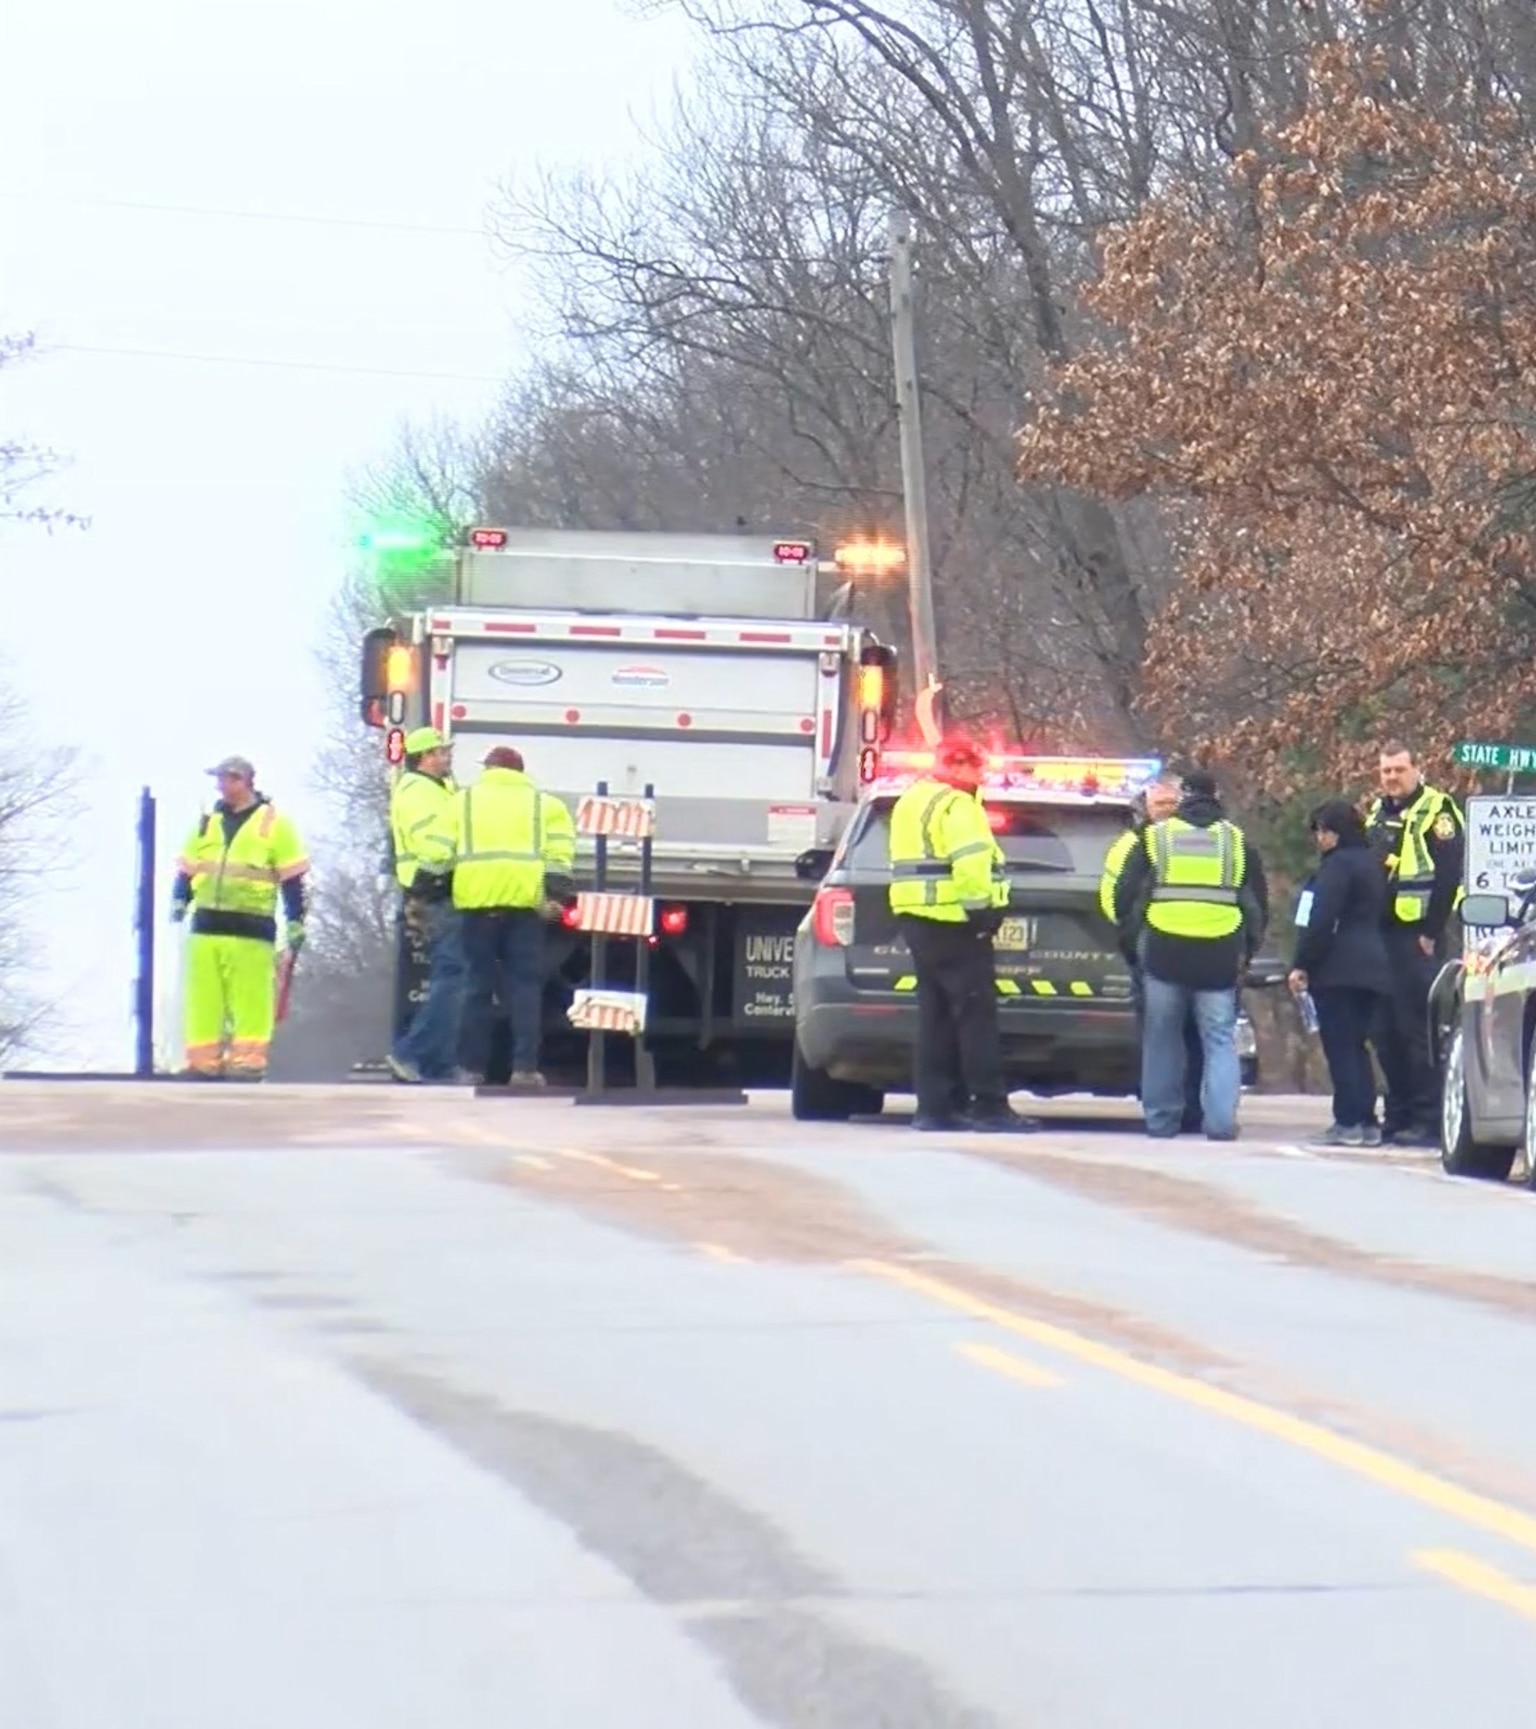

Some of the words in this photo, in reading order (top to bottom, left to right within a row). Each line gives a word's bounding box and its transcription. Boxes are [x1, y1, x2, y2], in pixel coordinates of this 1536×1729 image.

[1461, 744, 1500, 766] STATE
[1489, 841, 1536, 855] LIMIT
[1475, 871, 1490, 889] 6
[745, 965, 791, 979] TRUCK
